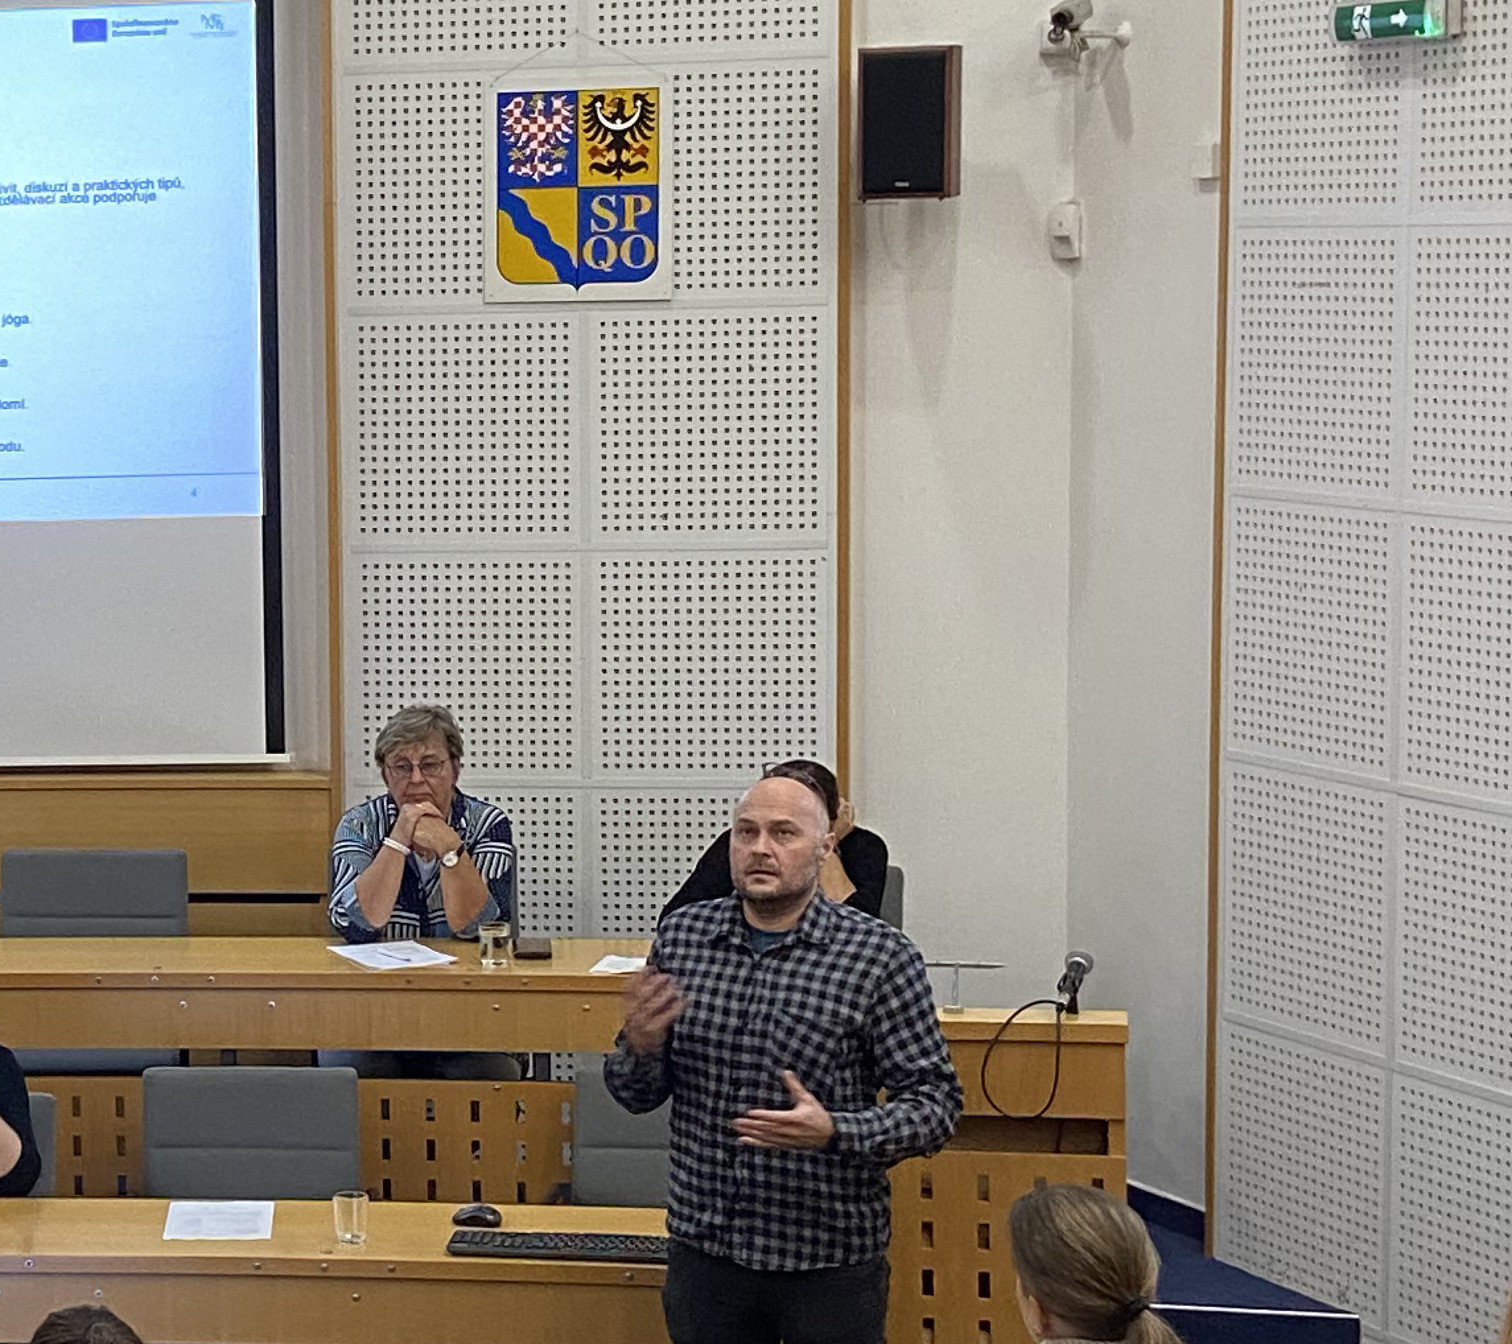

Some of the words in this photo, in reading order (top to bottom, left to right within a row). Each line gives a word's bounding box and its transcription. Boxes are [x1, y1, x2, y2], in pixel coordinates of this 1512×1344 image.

[59, 192, 89, 203] akce
[93, 190, 156, 205] podporuje
[590, 194, 653, 233] SP
[582, 234, 656, 272] QO
